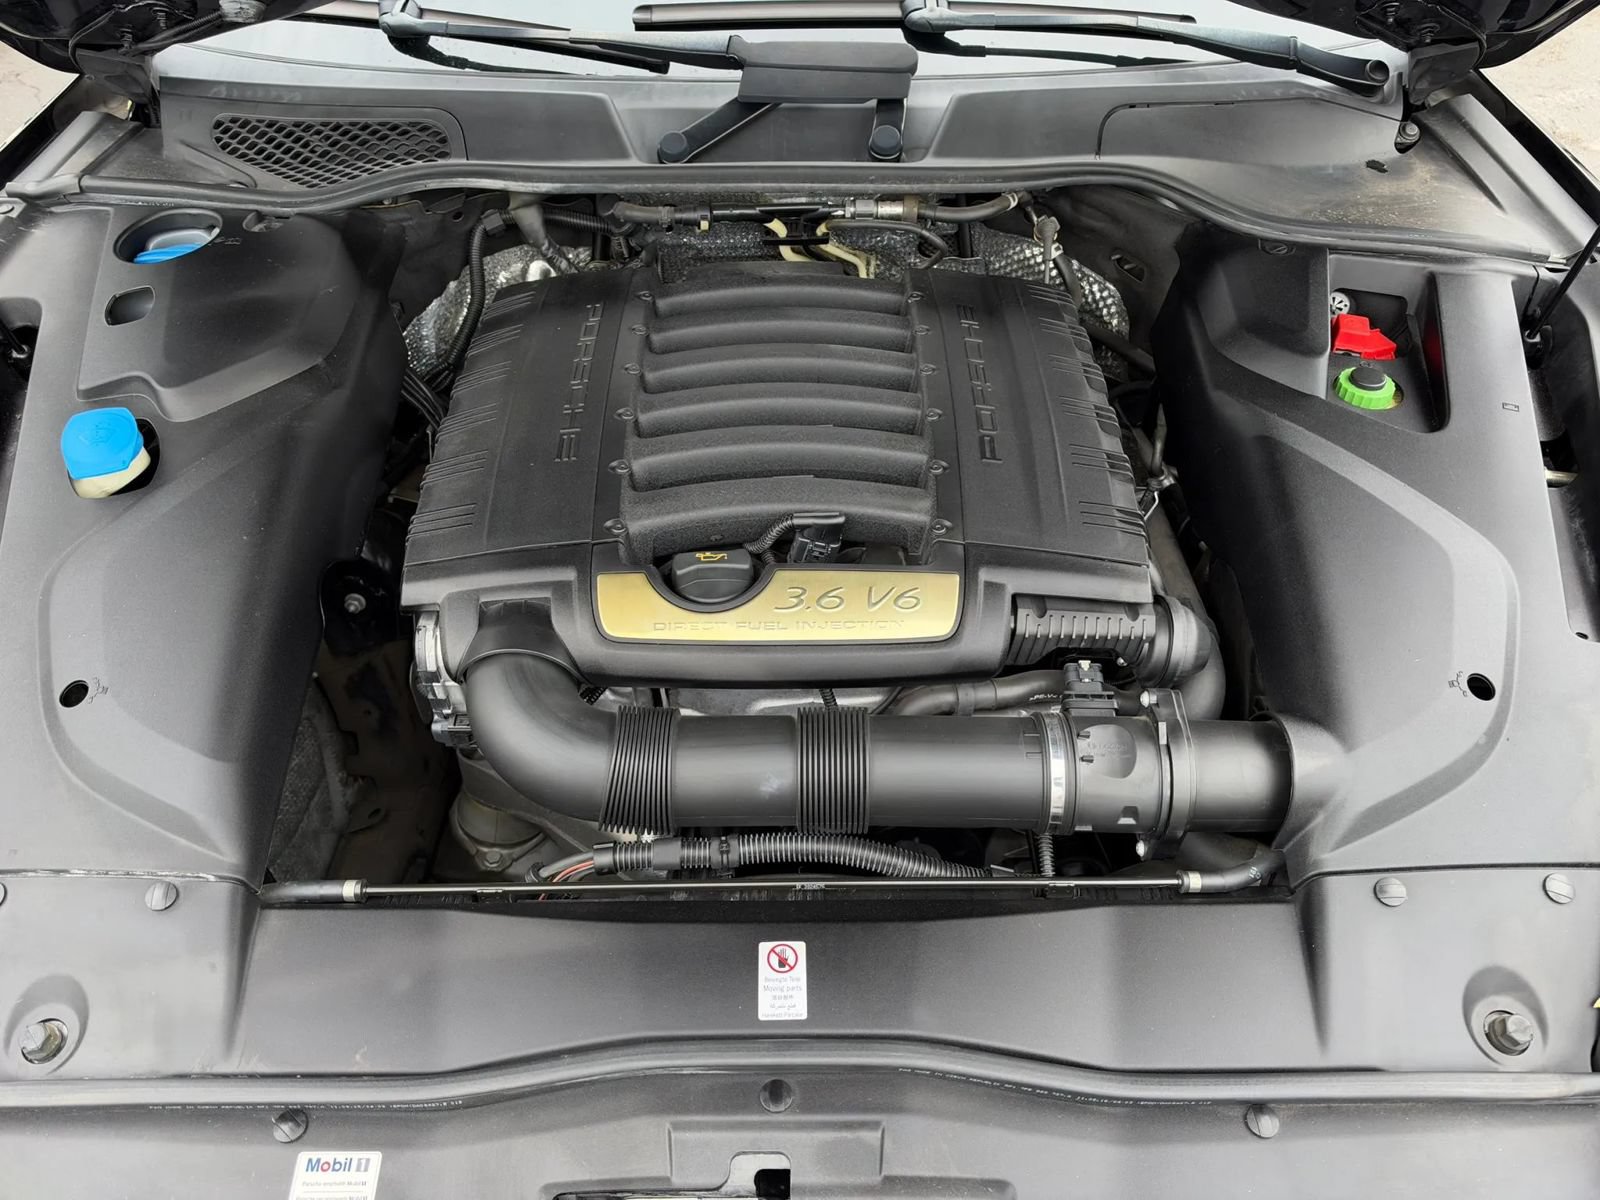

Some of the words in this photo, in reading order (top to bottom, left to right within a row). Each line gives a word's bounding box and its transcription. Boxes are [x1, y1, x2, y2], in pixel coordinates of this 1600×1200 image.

[553, 303, 602, 464] PORSCHE
[956, 303, 1003, 465] PORSCHE
[773, 586, 845, 612] 3.6
[867, 586, 922, 612] V6
[653, 621, 728, 632] DIRECT
[735, 621, 788, 631] FUEL
[796, 619, 905, 631] INJECTION
[786, 985, 803, 993] parts
[305, 1157, 353, 1173] Mobil
[355, 1157, 371, 1173] 1
